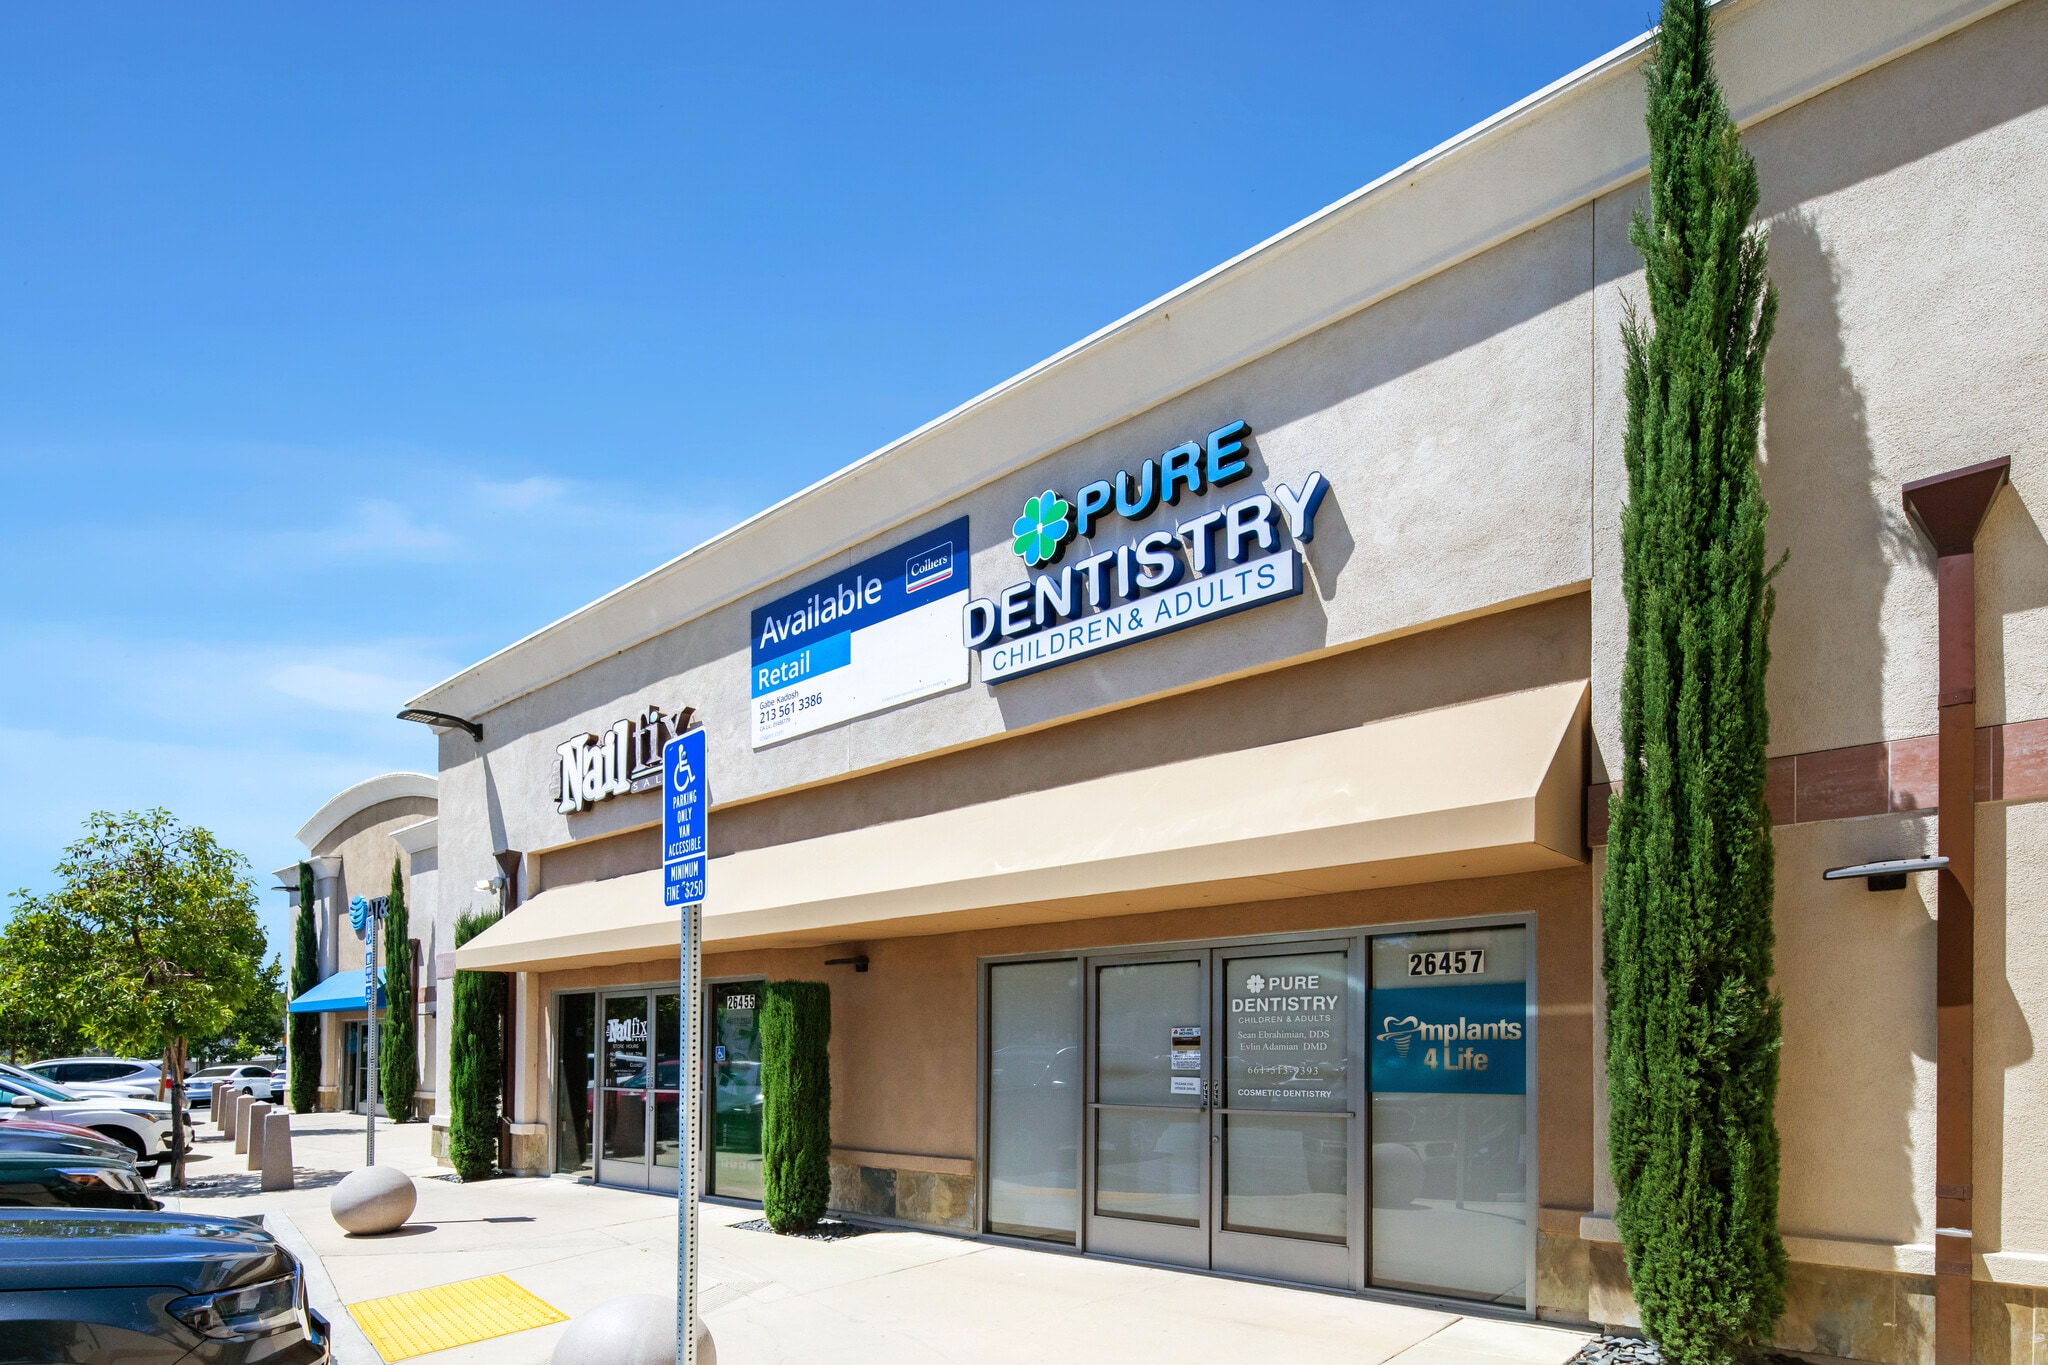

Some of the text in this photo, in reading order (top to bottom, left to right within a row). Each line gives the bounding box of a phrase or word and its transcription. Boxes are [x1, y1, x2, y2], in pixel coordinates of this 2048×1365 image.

[1077, 419, 1249, 536] PURE
[911, 555, 948, 577] Colliers
[963, 471, 1325, 650] DENTISTRY
[759, 575, 883, 650] Available
[993, 564, 1276, 671] CHILDREN & ADULTS
[758, 650, 810, 690] Retail
[760, 690, 799, 710] Gabe Kadosh
[760, 708, 777, 724] 213
[779, 702, 795, 717] 561
[799, 692, 823, 711] 3386
[556, 719, 631, 815] Nail
[632, 775, 662, 791] SAL
[672, 789, 697, 810] PARKING
[677, 807, 693, 824] ONLY
[678, 823, 690, 839] VAN
[668, 836, 702, 857] ACCESSIBLE
[670, 860, 699, 882] MINIMUM
[666, 879, 703, 902] FINE $250
[368, 896, 389, 919] AT&
[1410, 950, 1483, 976] 26457
[1268, 975, 1320, 991] PURE
[728, 995, 755, 1009] 26455
[1231, 995, 1338, 1013] DENTISTRY
[1238, 1016, 1283, 1024] CHILDREN
[1295, 1014, 1331, 1022] ADULTS
[607, 1017, 648, 1043] Nail fix
[1238, 1030, 1330, 1040] Sean Ebrahimian, DDS
[1240, 1042, 1328, 1051] Evlin Adamian DMD
[1424, 1047, 1489, 1071] 4 Life
[1247, 1065, 1319, 1075] 661-513-9393
[1237, 1089, 1332, 1098] COSMETIC DENTISTRY
